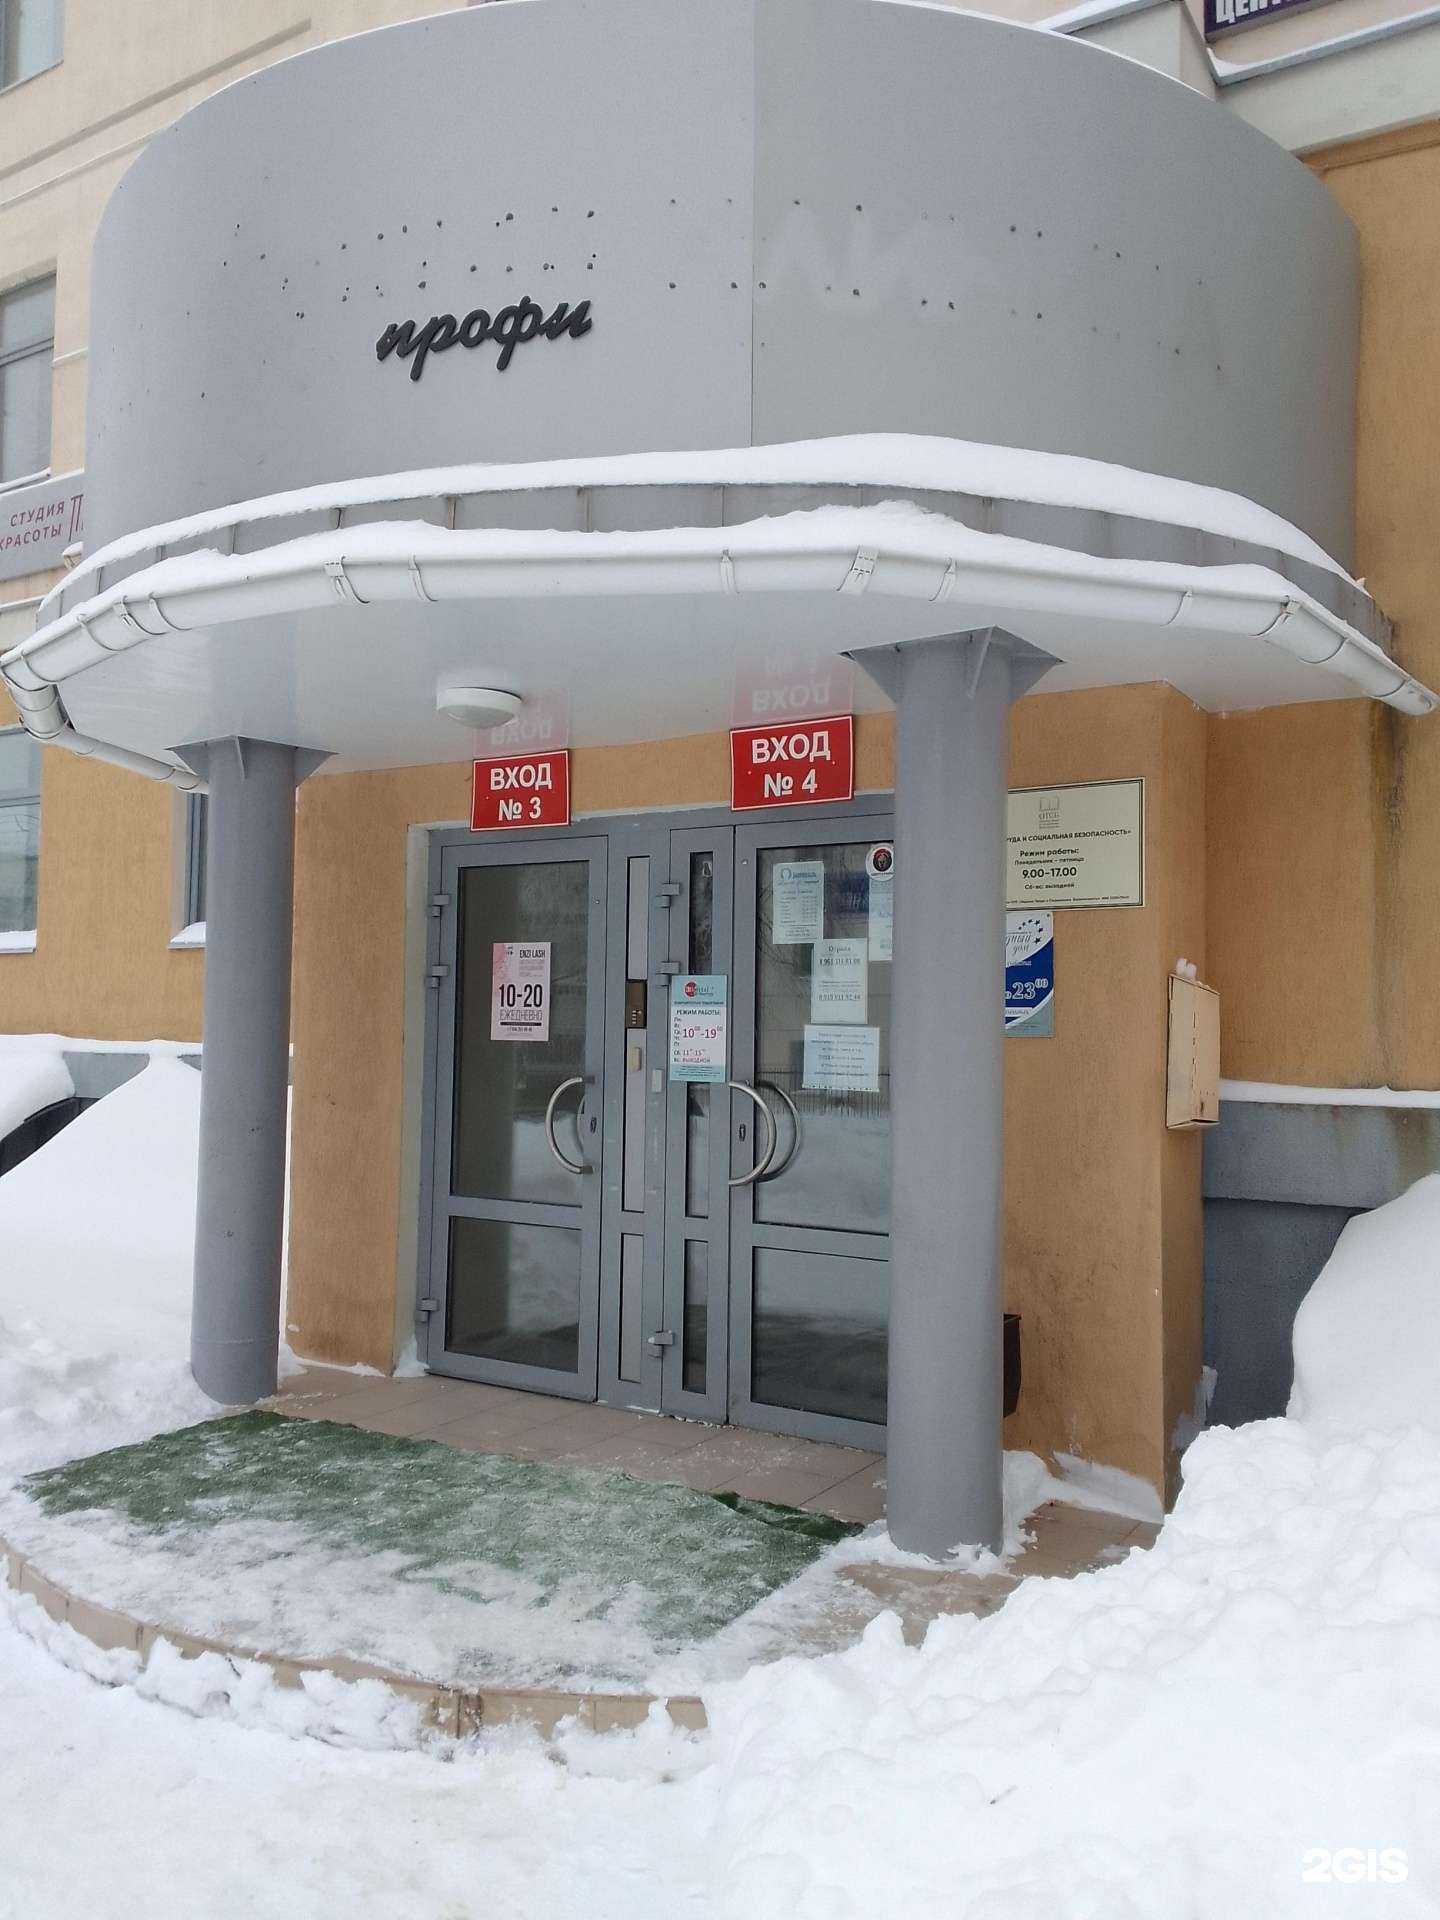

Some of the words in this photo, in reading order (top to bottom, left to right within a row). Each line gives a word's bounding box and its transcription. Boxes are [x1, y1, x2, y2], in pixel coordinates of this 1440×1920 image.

[376, 296, 592, 382] профи
[10, 500, 65, 527] СТУДИЯ
[751, 730, 831, 764] ВХОД
[490, 762, 552, 791] ВХОД
[763, 772, 794, 798] №
[801, 768, 818, 794] 4
[498, 798, 523, 821] №
[529, 796, 541, 819] 3
[1028, 832, 1073, 842] СОЦИАЛЬНАЯ
[1014, 858, 1053, 866] Понедельник
[1019, 850, 1045, 858] Режим
[1046, 848, 1080, 857] работы:
[499, 983, 543, 1008] 10-20
